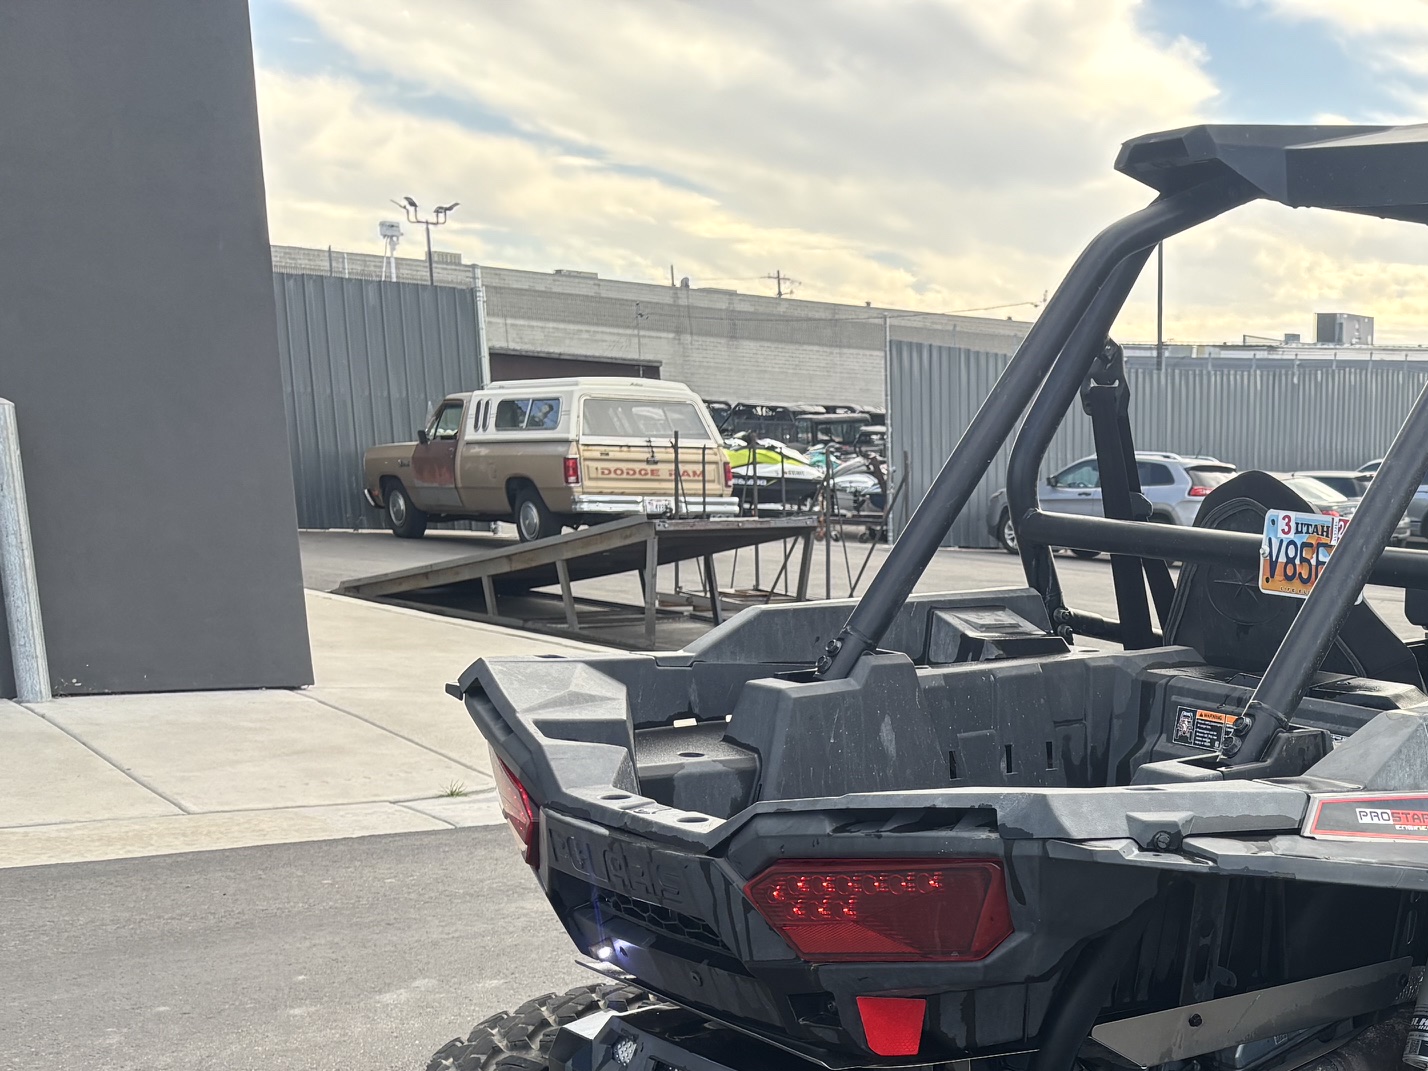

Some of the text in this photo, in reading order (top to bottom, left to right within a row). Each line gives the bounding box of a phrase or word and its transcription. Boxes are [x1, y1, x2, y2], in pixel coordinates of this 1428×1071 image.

[600, 467, 703, 478] DODGE RAM
[1281, 514, 1292, 535] 3
[1294, 522, 1331, 539] UTAH
[549, 828, 686, 905] POLARIS
